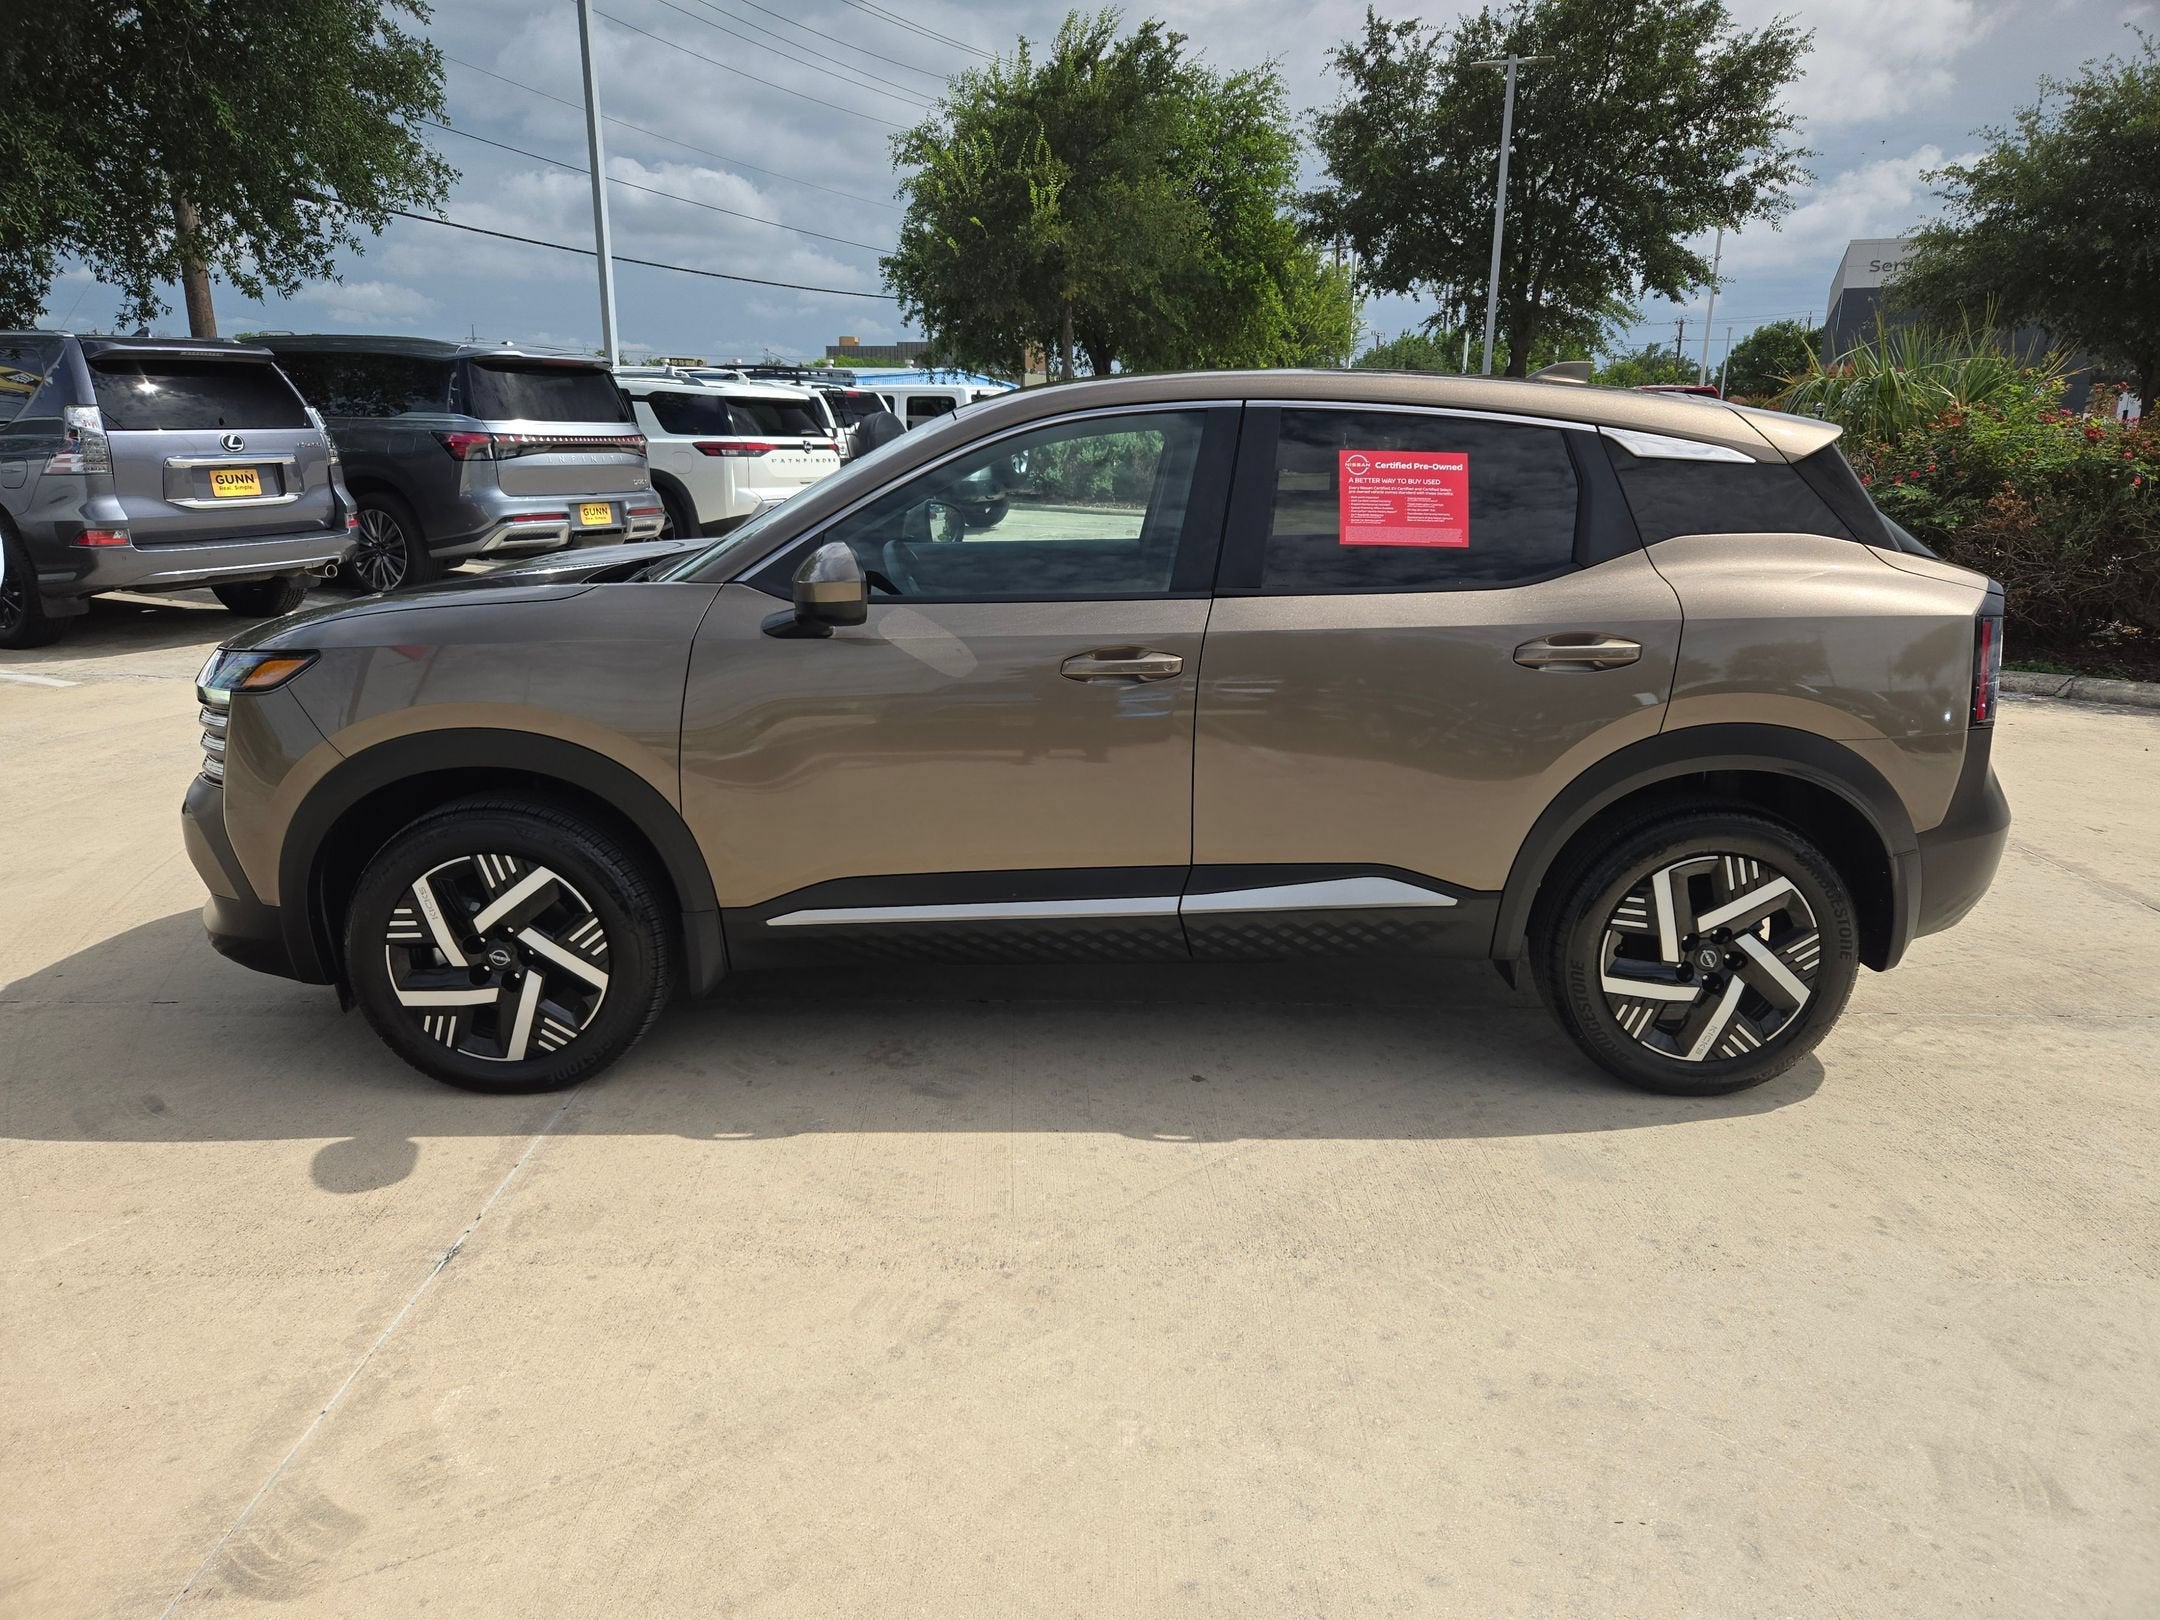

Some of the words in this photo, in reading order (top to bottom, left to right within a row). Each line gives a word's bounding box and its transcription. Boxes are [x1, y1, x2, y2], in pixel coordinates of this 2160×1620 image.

[1375, 461, 1412, 470] Certified
[1413, 462, 1463, 471] Pre-Owned
[215, 473, 255, 485] GUNN
[583, 506, 608, 516] GUNN
[418, 886, 438, 920] KICKS
[1696, 1025, 1718, 1055] KICKS
